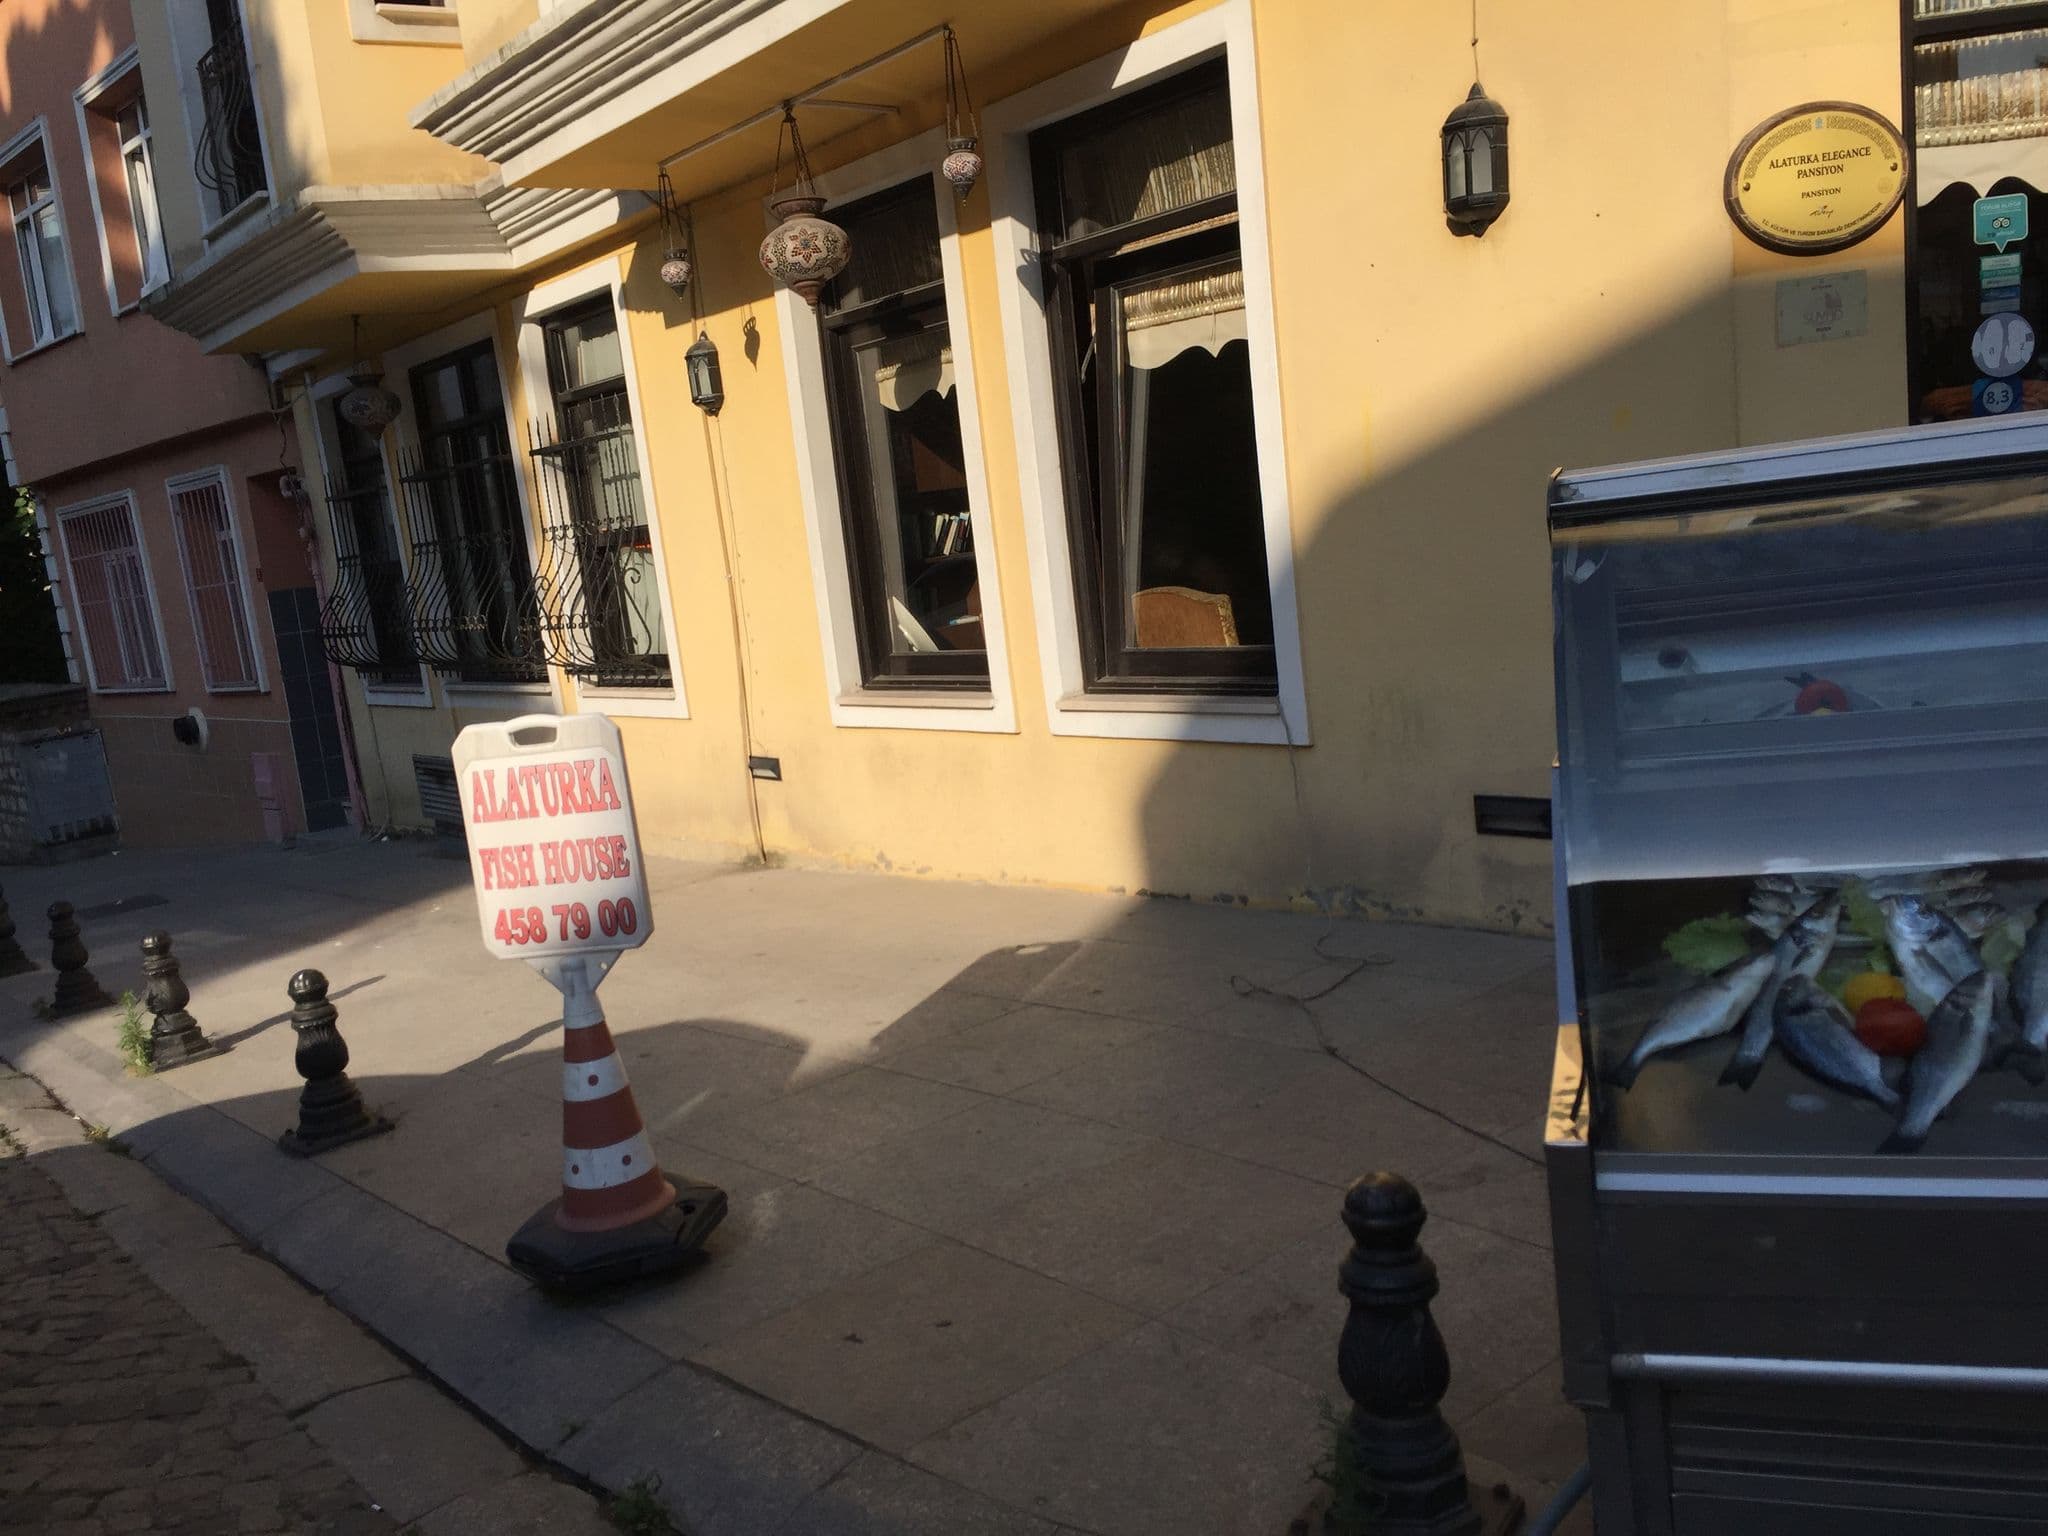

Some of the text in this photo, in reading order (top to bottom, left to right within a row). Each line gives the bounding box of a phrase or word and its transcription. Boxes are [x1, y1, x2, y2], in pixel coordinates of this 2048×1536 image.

[1769, 147, 1871, 169] ALATURKA ELEGANCE
[1986, 390, 2010, 404] 8,3
[472, 758, 621, 823] ALATURKA
[479, 835, 631, 890] FISH HOUSE
[495, 897, 638, 945] 458 79 00
